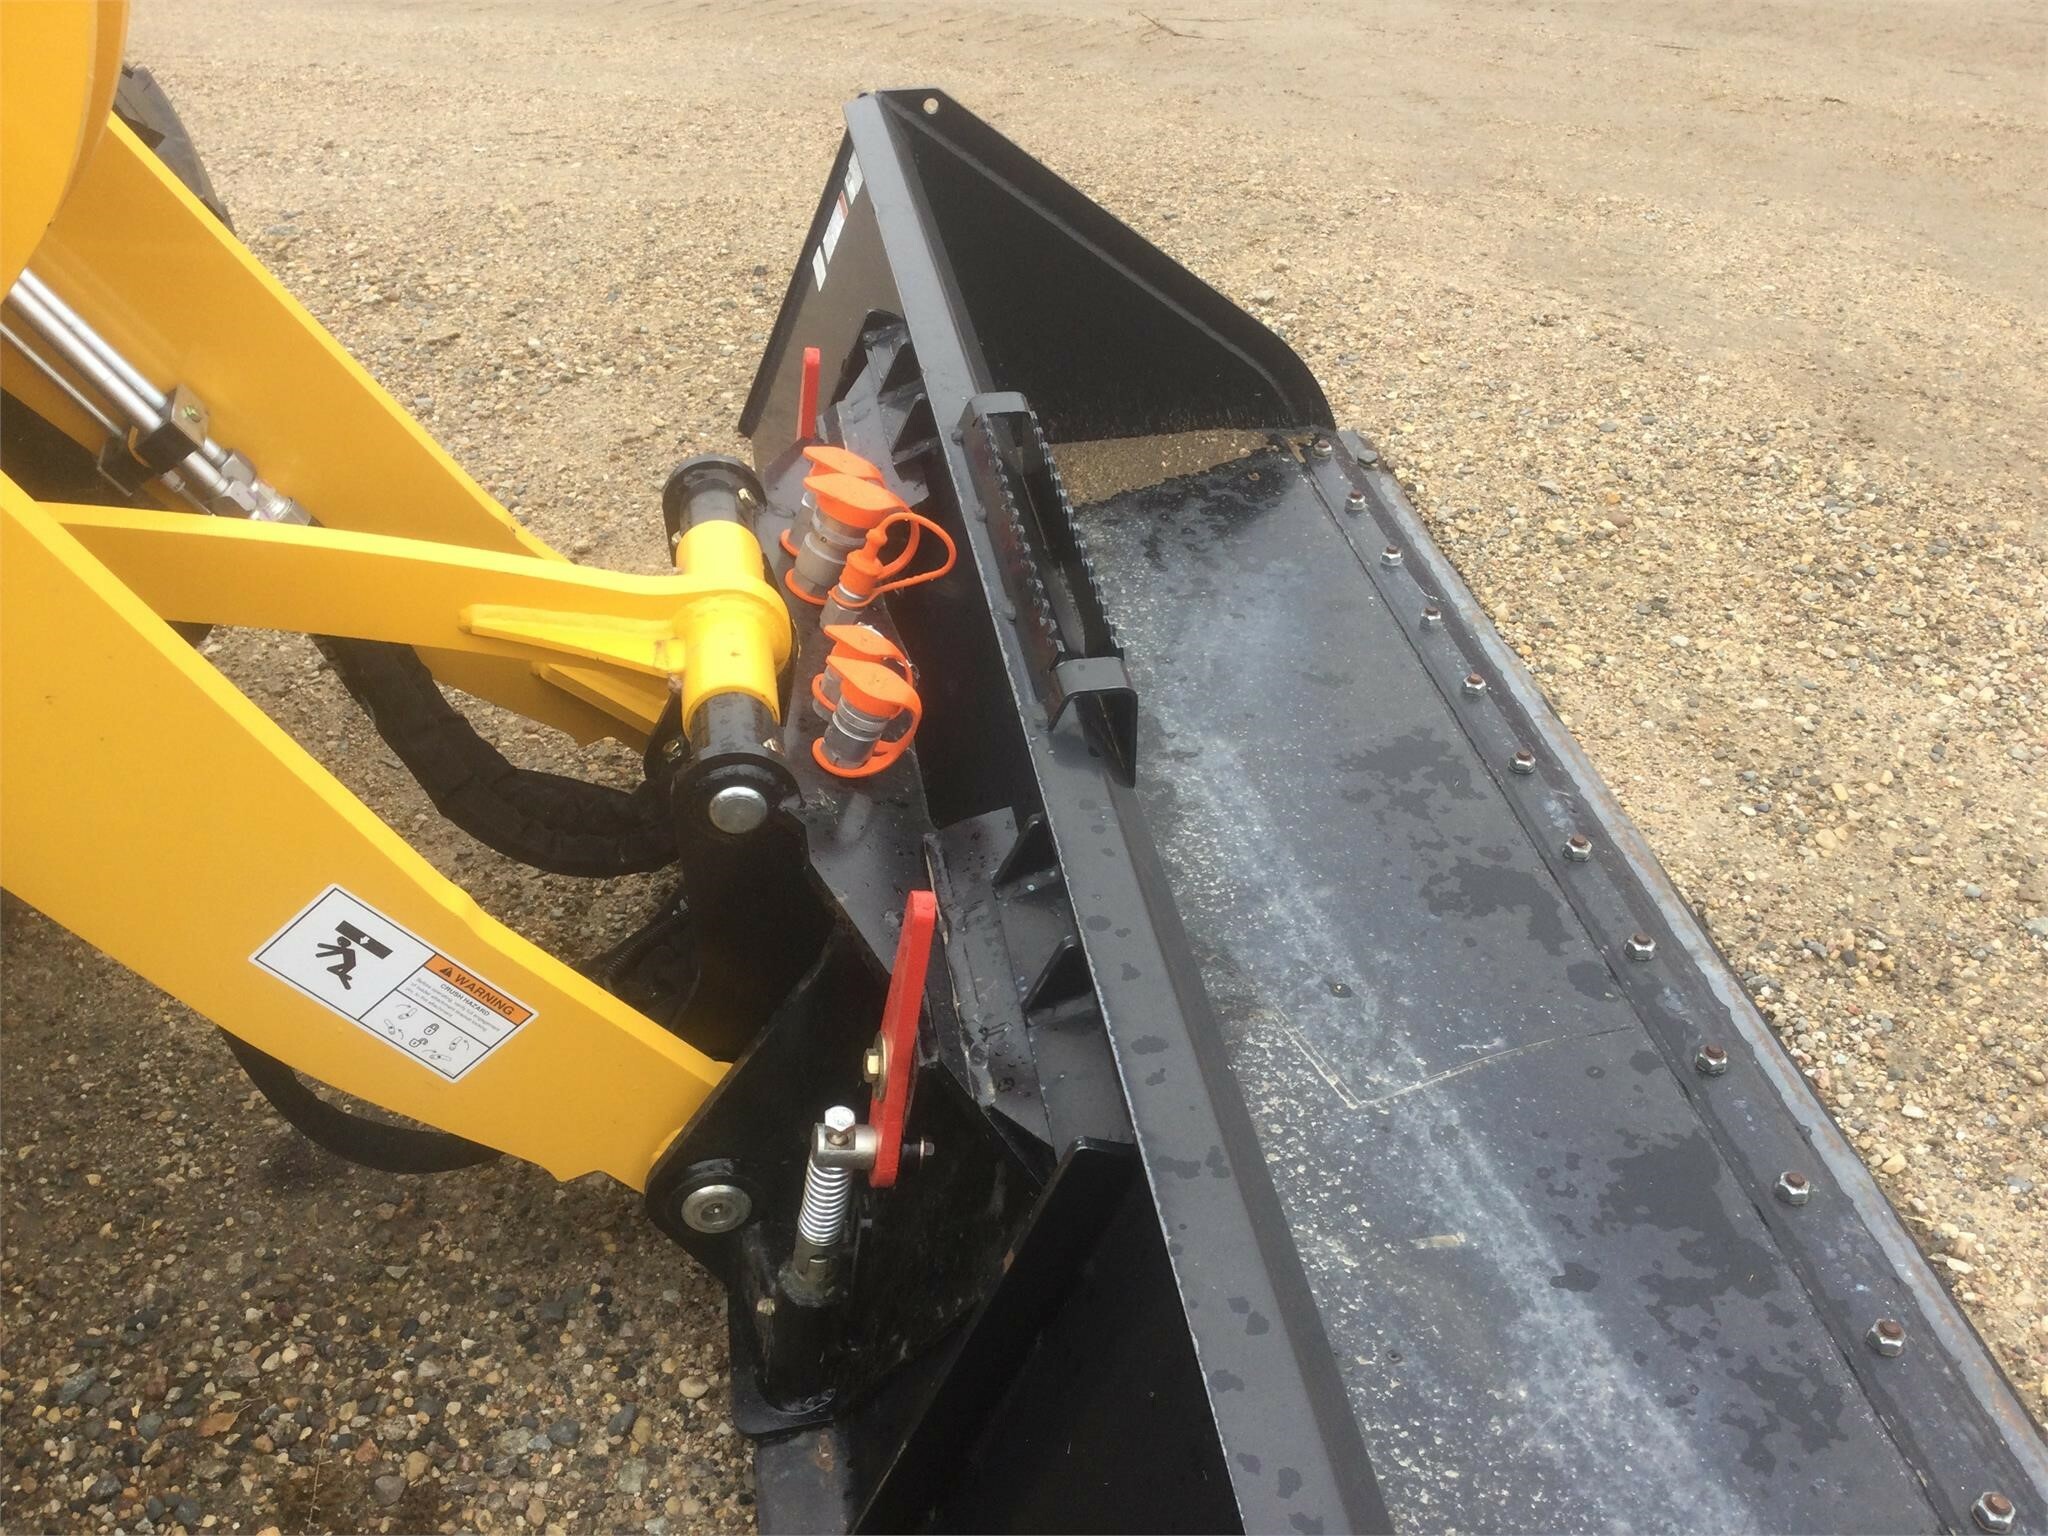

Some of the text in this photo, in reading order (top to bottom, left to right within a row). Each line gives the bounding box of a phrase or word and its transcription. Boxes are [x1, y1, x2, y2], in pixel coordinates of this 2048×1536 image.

[440, 983, 464, 1000] CRUSH
[463, 997, 490, 1016] HAZARD
[454, 974, 514, 1016] WARNING
